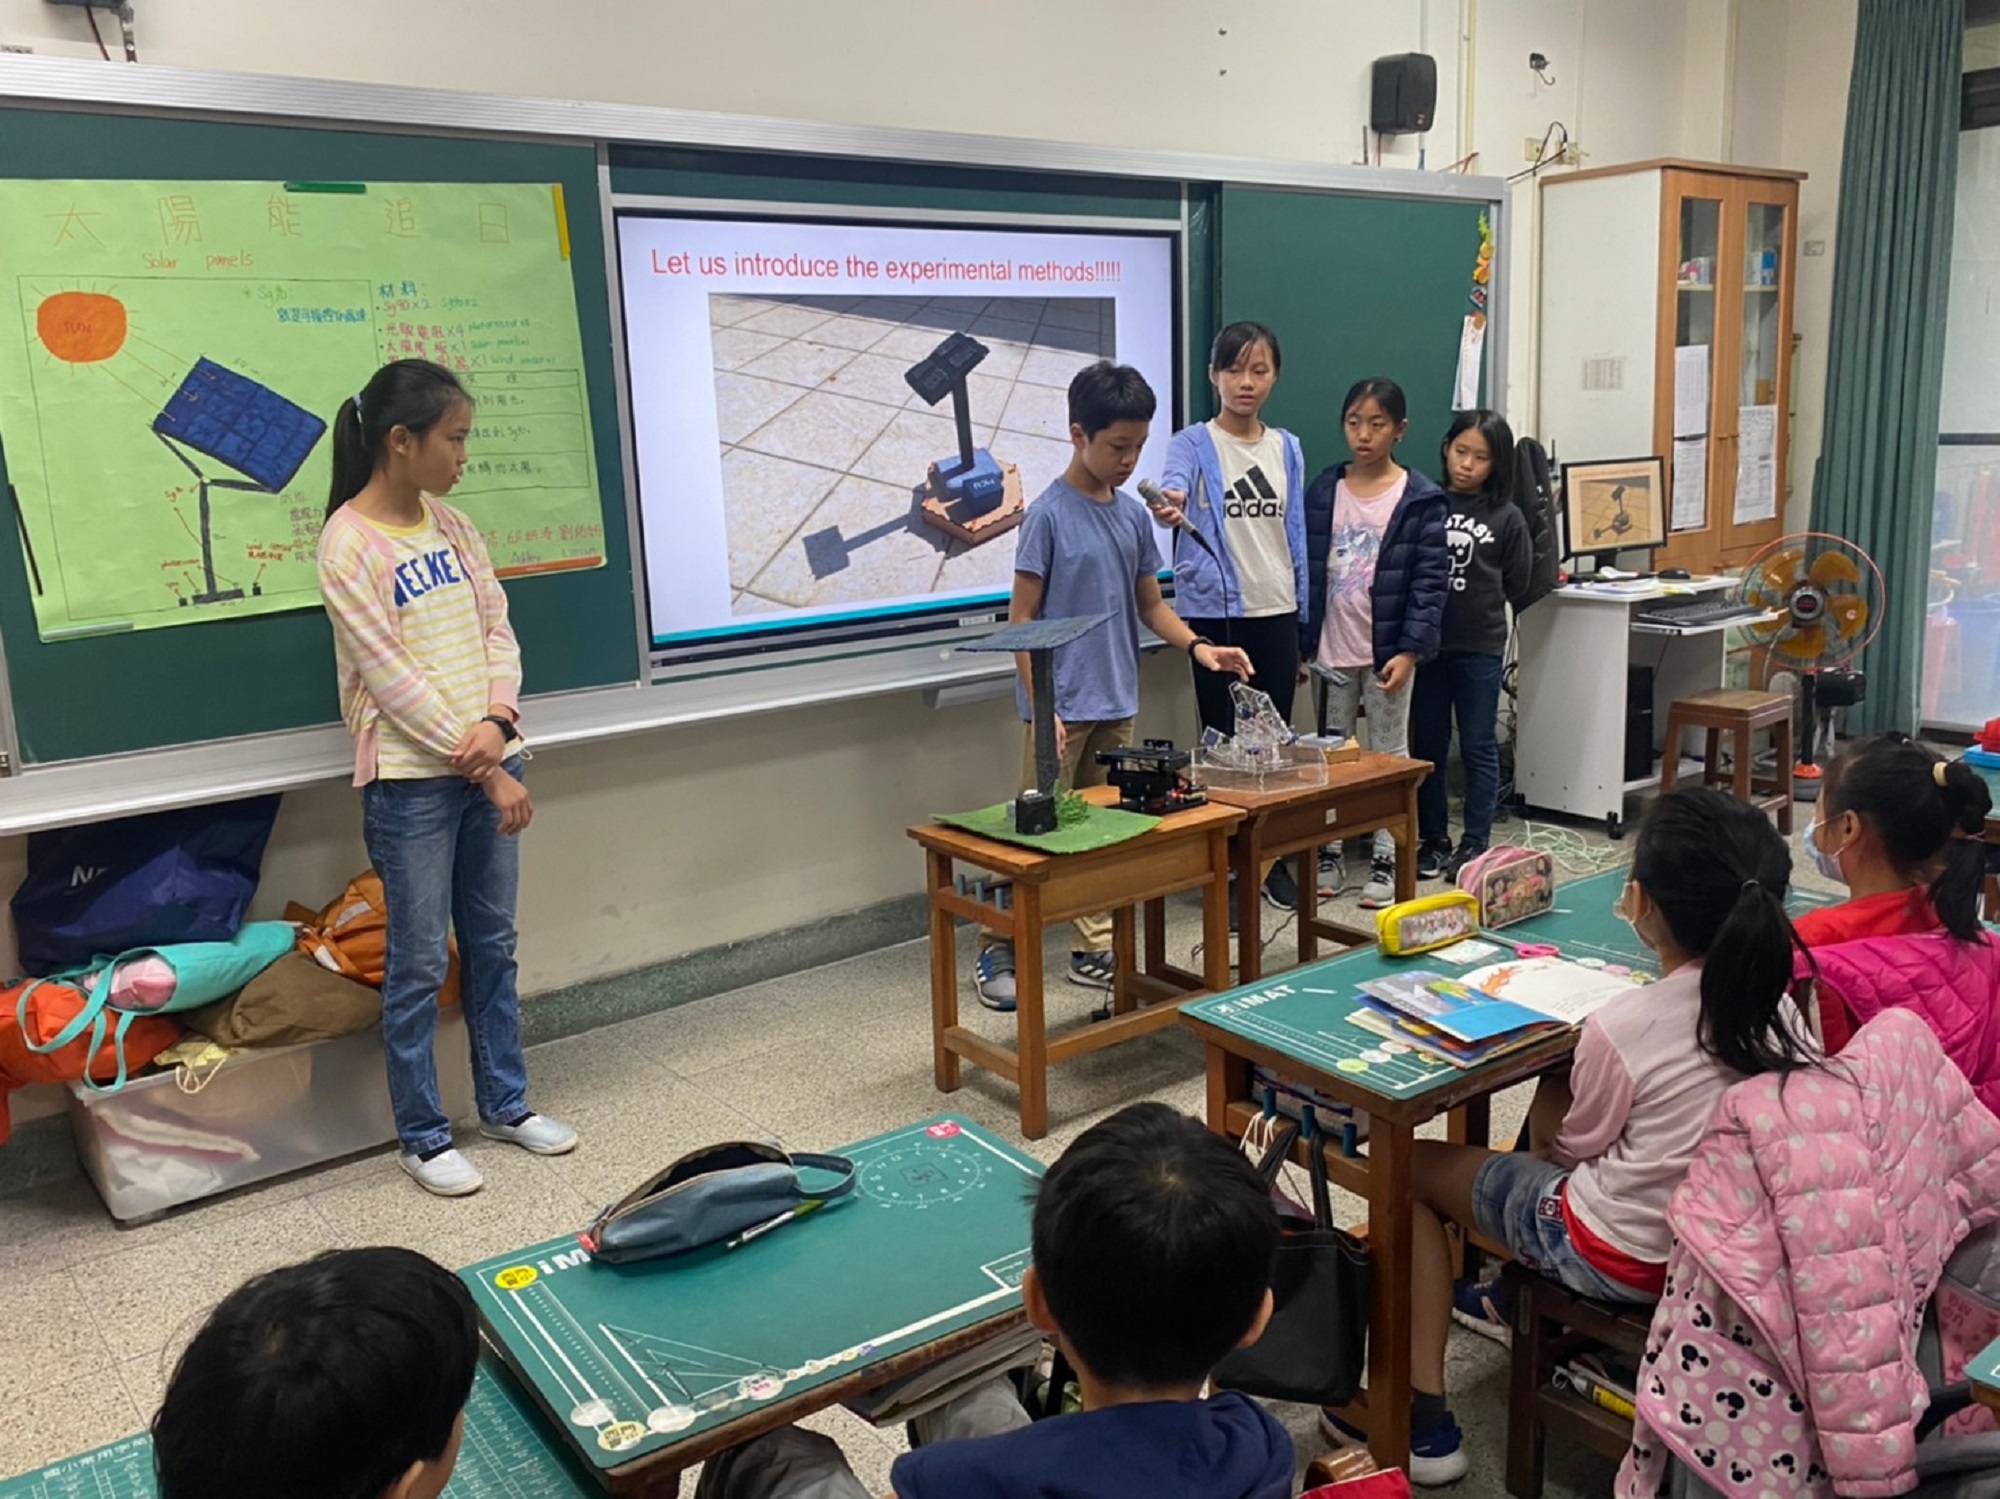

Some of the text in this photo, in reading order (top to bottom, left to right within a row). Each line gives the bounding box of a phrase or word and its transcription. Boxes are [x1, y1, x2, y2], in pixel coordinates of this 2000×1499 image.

[205, 249, 255, 272] panels
[651, 248, 1121, 284] Let us introduce the experimental methods!!!!!
